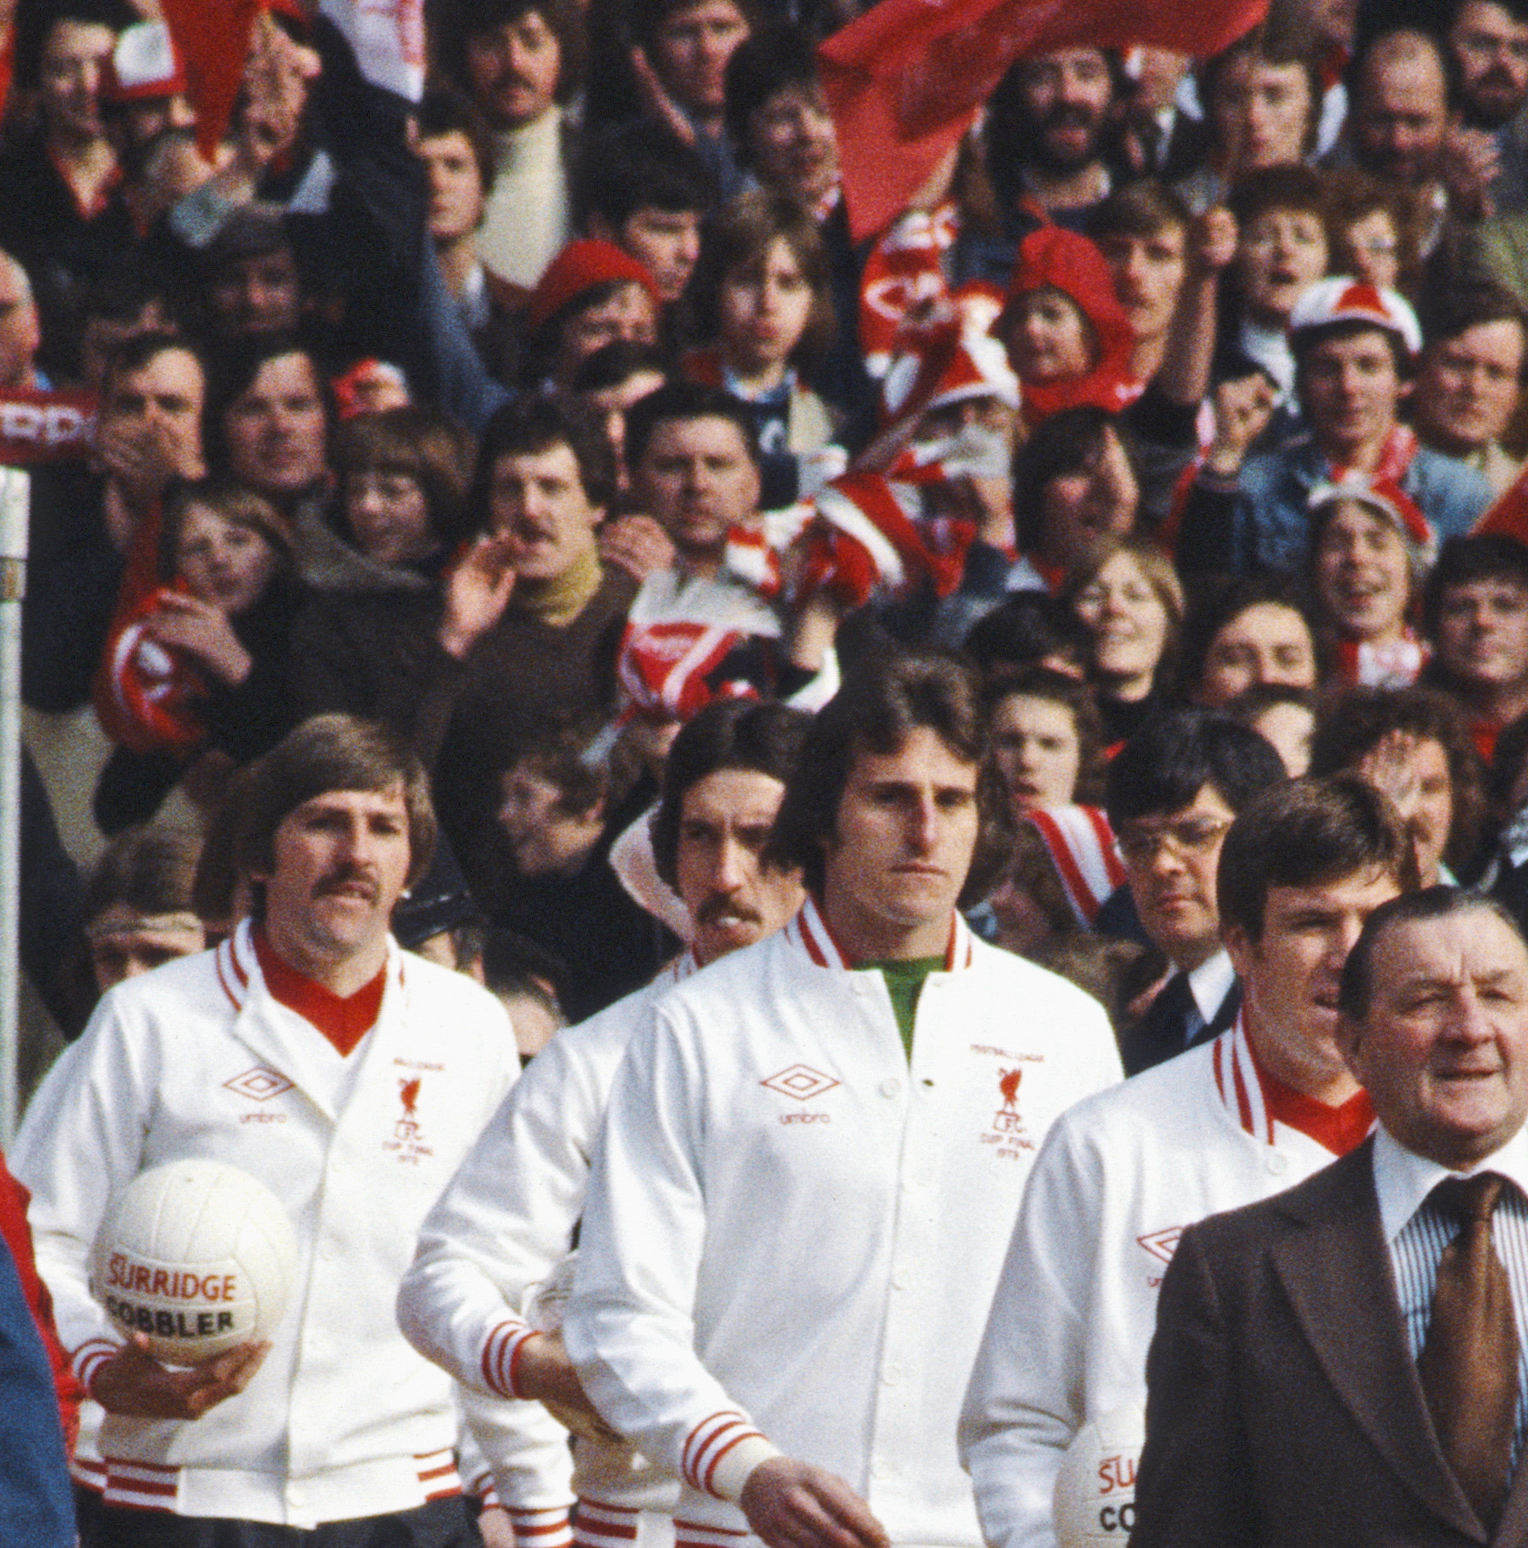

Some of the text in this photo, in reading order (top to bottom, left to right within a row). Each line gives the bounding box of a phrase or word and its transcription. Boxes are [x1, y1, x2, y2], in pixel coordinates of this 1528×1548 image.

[779, 1106, 831, 1126] umbro
[107, 1252, 237, 1301] SURRIDGE
[107, 1296, 234, 1338] COBBLER
[1099, 1503, 1136, 1532] CO
